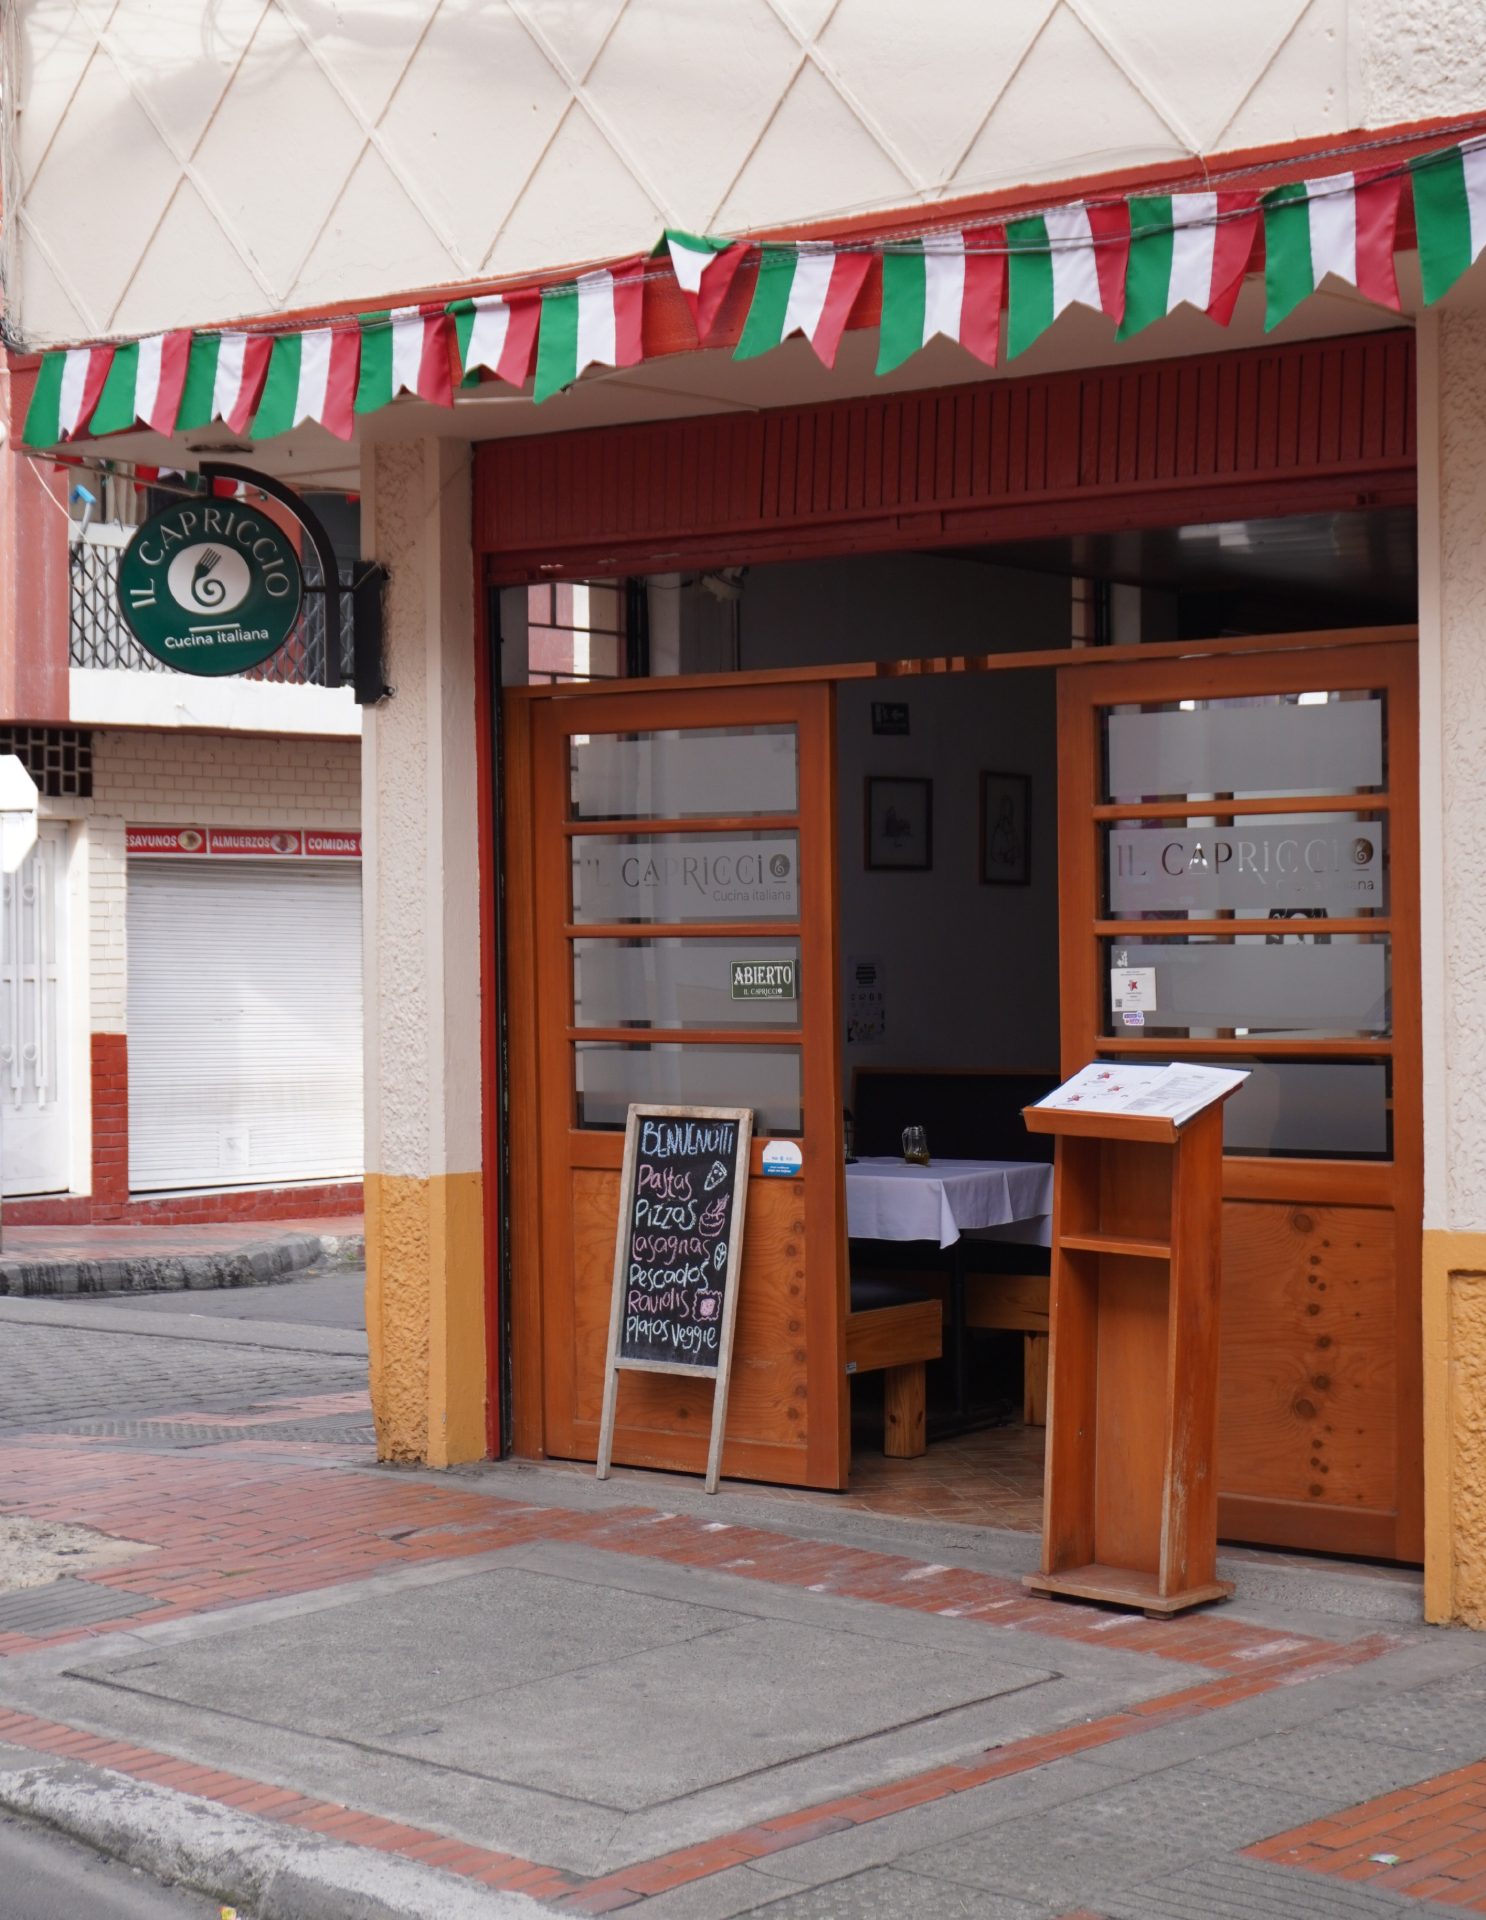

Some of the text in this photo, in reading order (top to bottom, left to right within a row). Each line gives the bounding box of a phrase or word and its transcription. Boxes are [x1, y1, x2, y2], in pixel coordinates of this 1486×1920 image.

[130, 508, 290, 609] IL CAPRICCIO
[164, 628, 269, 649] Cucina italiana
[212, 835, 271, 849] ALMUERZOS
[308, 837, 357, 851] COMIDAS
[1117, 844, 1147, 877] IL
[712, 888, 792, 902] Cucina italiana
[733, 965, 792, 986] ABIERTO
[637, 1164, 692, 1202] Pastas
[635, 1199, 698, 1231] Pizzas
[632, 1232, 710, 1265] Lasagnas
[629, 1261, 710, 1291] Pescados
[628, 1287, 690, 1318] Raviolis
[626, 1315, 671, 1344] Platos
